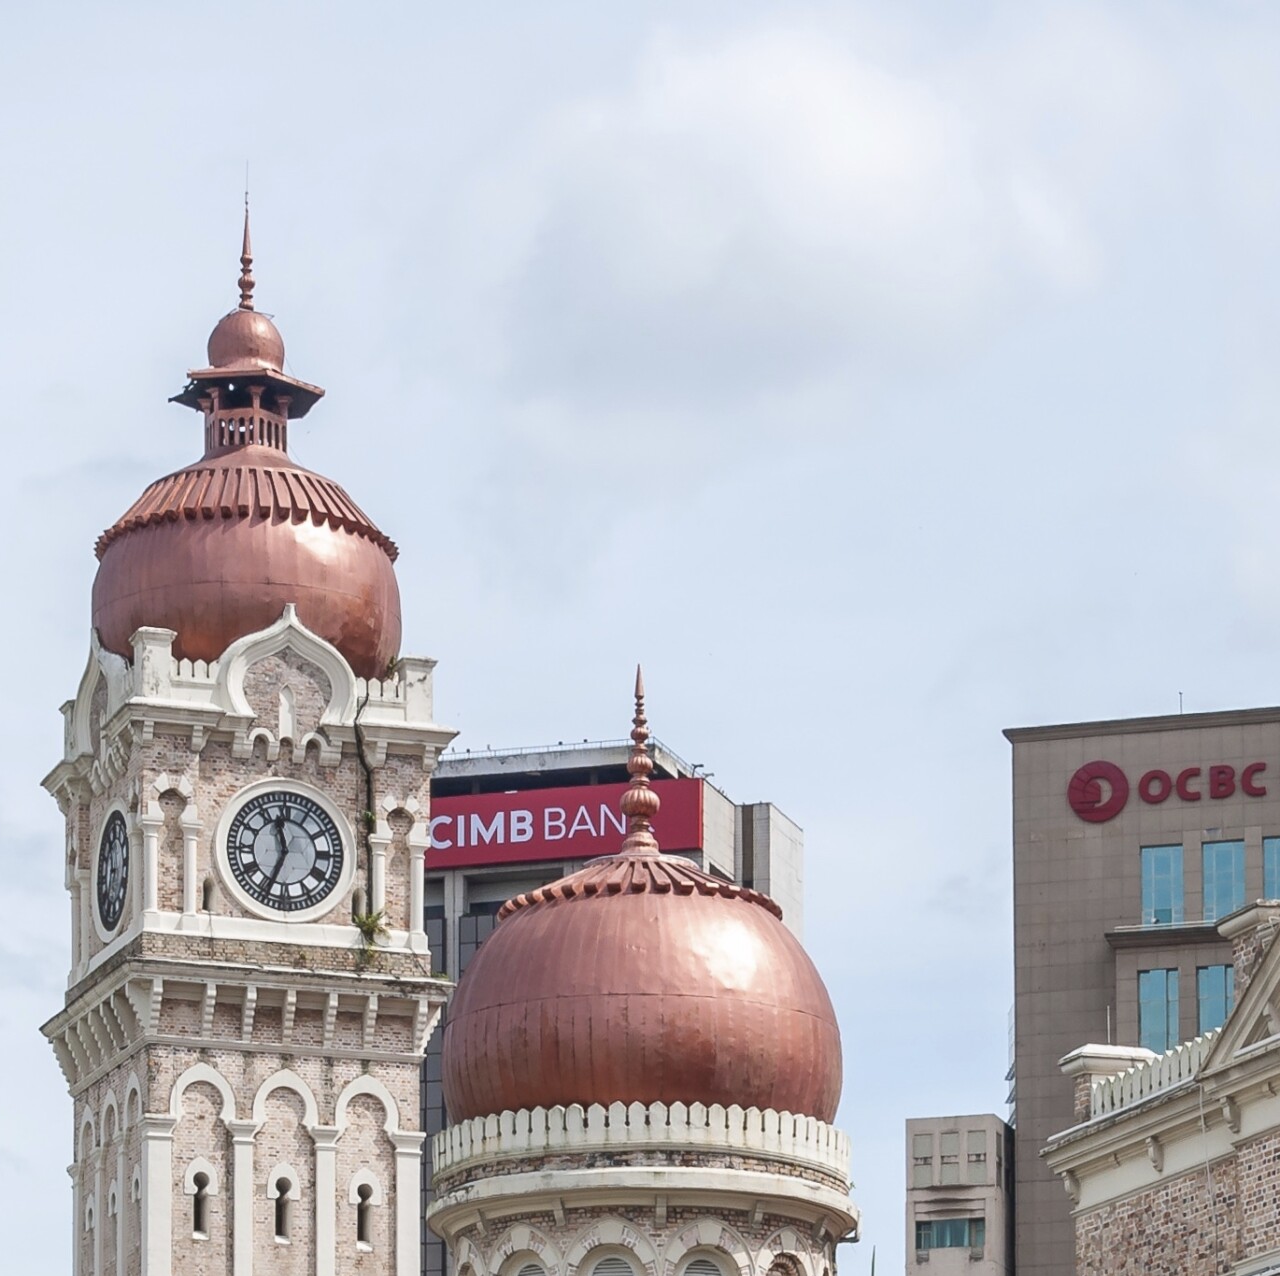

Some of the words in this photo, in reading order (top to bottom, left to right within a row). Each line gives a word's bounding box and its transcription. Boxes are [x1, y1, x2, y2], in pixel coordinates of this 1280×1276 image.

[1138, 762, 1267, 805] OCBC
[430, 809, 534, 850] CIMB
[544, 803, 655, 841] BAN
